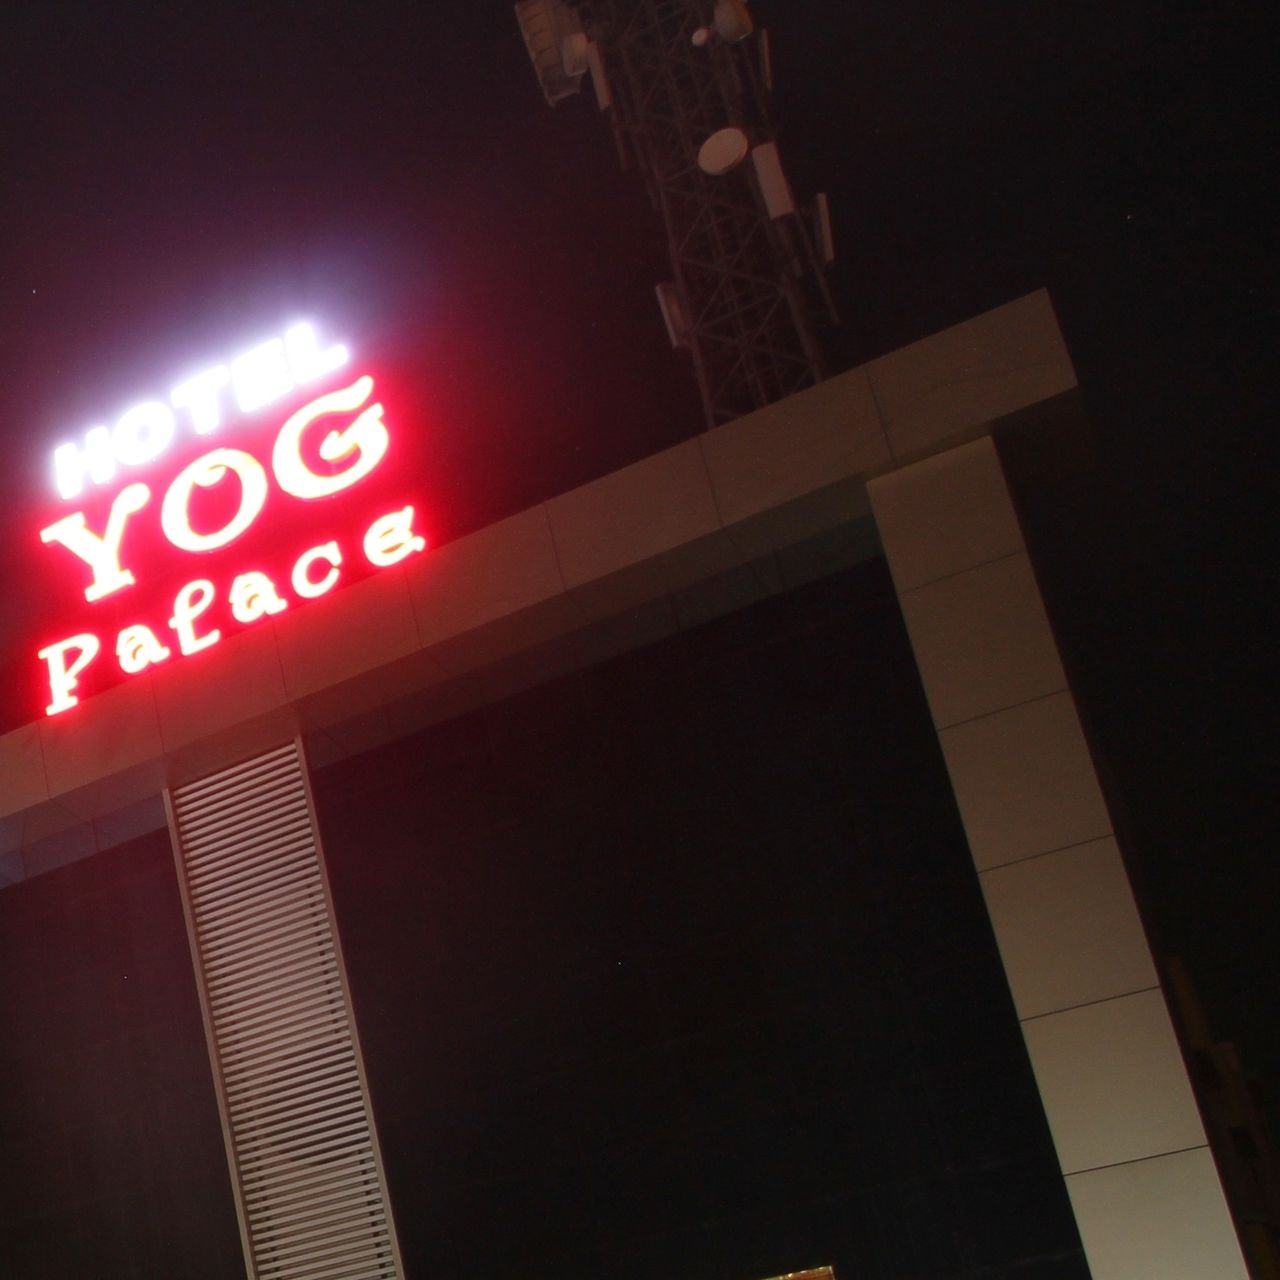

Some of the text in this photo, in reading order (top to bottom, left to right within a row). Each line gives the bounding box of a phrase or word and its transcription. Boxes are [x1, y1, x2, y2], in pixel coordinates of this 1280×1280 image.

[40, 374, 390, 603] YOG
[53, 320, 349, 500] HOTEL
[37, 505, 426, 716] Palace
